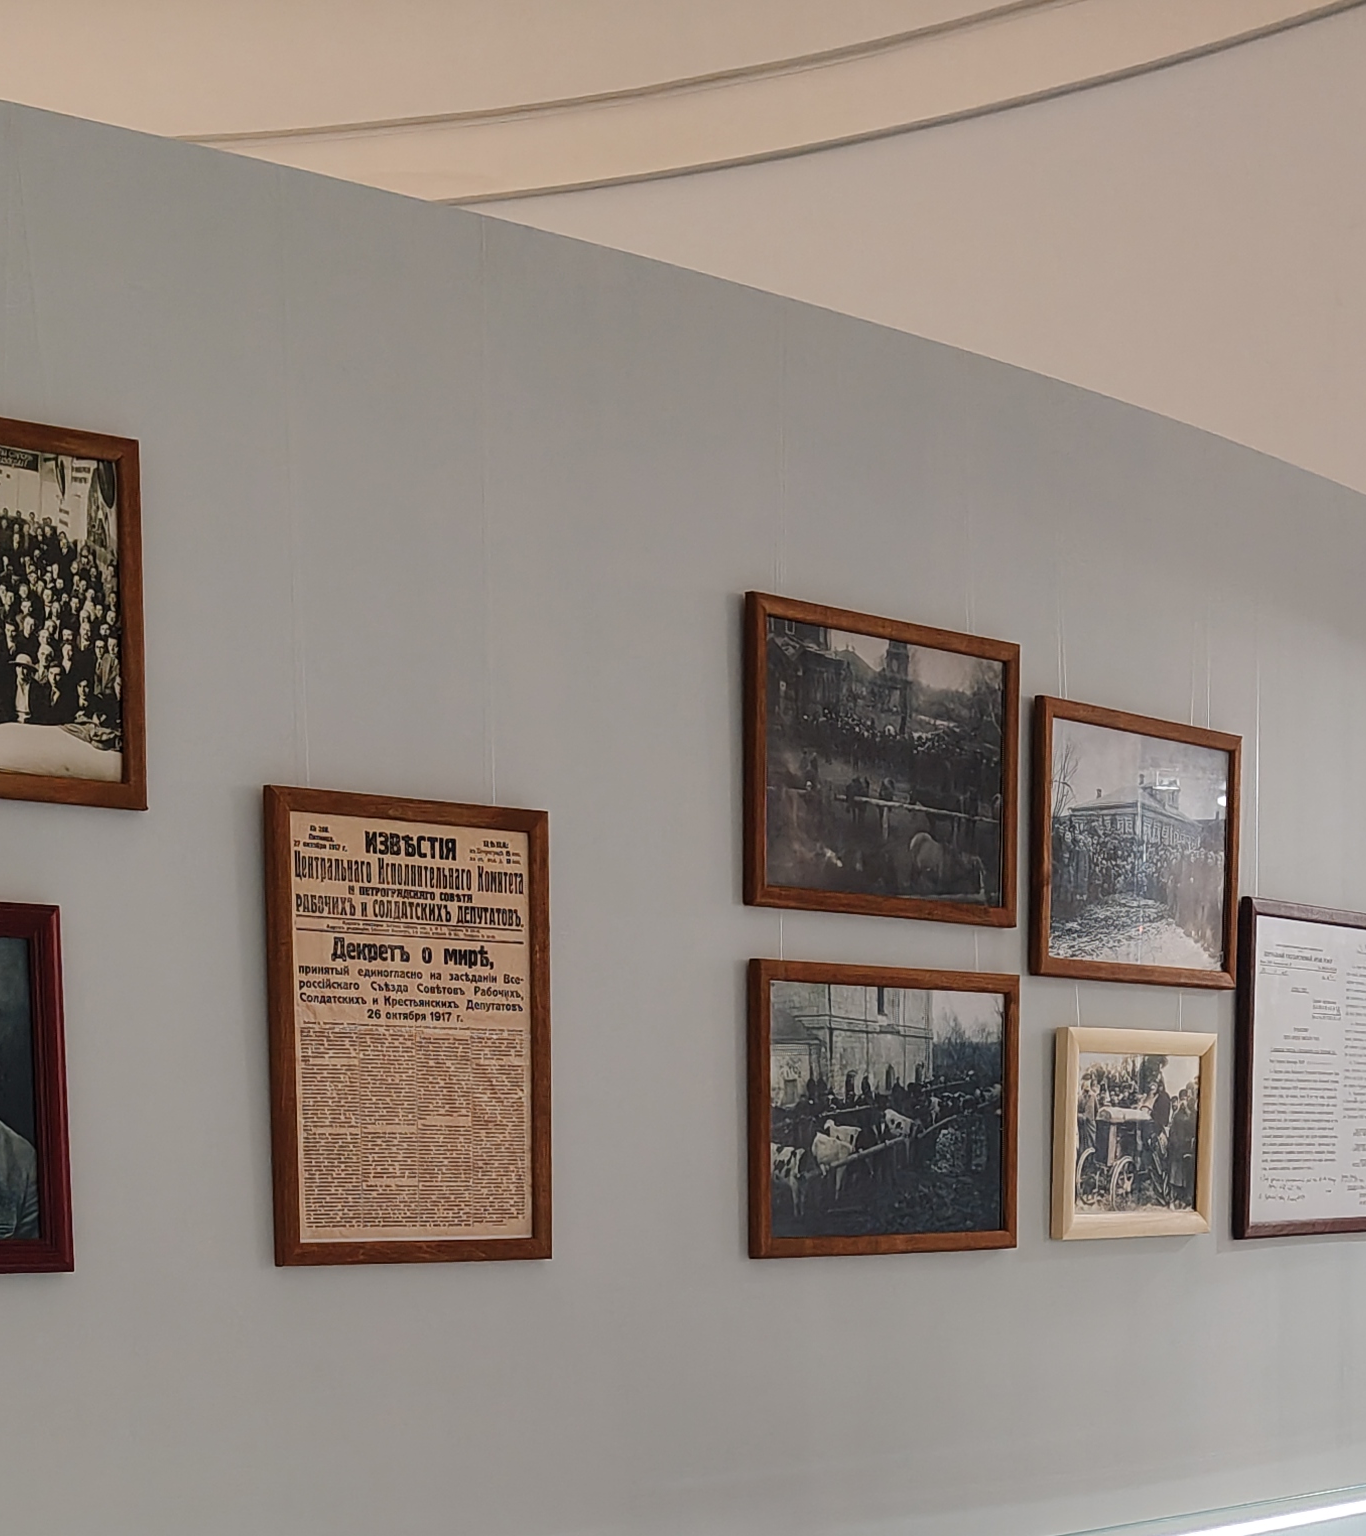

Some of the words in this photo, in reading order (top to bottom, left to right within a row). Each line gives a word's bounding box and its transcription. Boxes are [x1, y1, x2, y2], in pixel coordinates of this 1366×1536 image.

[364, 830, 457, 861] ИЗВѢСТІЯ
[294, 850, 372, 883] Центральнаго
[378, 857, 472, 892] Исполнительнаго
[477, 865, 524, 895] Комитета
[295, 893, 356, 916] РАБОЧИХЪ
[373, 899, 452, 922] СОЛДАТСКИХЪ
[456, 905, 524, 928] ДЕПУТАТОВЪ.
[331, 936, 411, 963] Декретъ
[421, 946, 433, 964] о
[443, 945, 495, 970] мирѣ,
[298, 965, 350, 976] принятый
[357, 968, 423, 979] единогласно
[430, 971, 442, 981] на
[448, 971, 498, 984] засѣданіи
[503, 973, 525, 985] Все-
[298, 979, 360, 991] россійскаго
[370, 981, 409, 994] Съѣзда
[416, 983, 466, 996] Совѣтовъ
[473, 986, 525, 1001] Рабочихъ,
[299, 992, 368, 1005] Солдатскихъ
[372, 997, 379, 1006] и
[384, 996, 460, 1009] Крестьянскихъ
[465, 999, 524, 1012] Депутатовъ
[366, 1008, 382, 1020] 26
[385, 1011, 427, 1023] октября
[430, 1011, 452, 1023] 1917
[456, 1014, 464, 1023] г.
